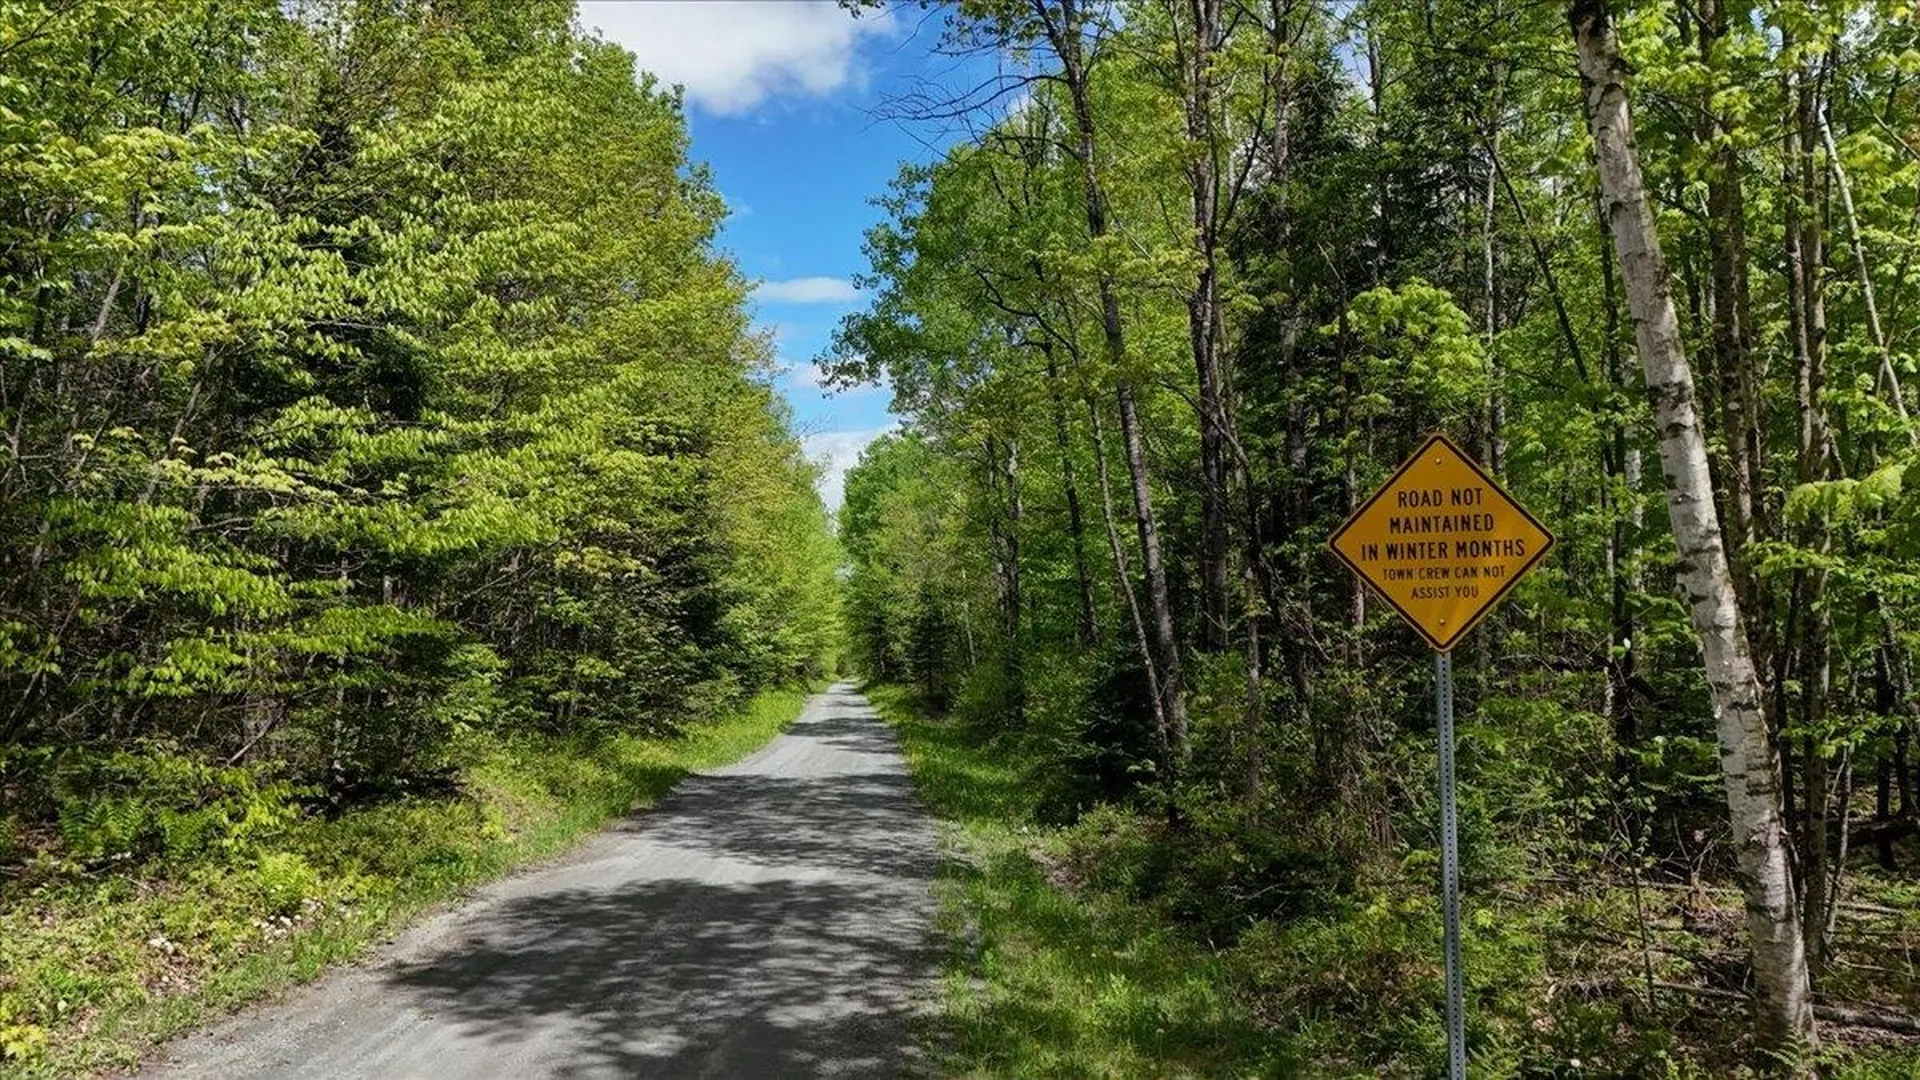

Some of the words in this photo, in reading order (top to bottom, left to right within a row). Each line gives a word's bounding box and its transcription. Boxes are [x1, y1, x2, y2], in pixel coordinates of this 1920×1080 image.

[1397, 489, 1442, 508] ROAD
[1451, 488, 1483, 506] NOT
[1390, 513, 1494, 534] MAINTAINED
[1362, 544, 1378, 561] IN
[1386, 542, 1448, 561] WINTER
[1456, 539, 1525, 558] MONTHS
[1383, 569, 1413, 581] TOWN
[1419, 567, 1450, 579] CREW
[1455, 566, 1478, 578] CAN
[1484, 566, 1506, 578] NOT
[1411, 587, 1450, 599] ASSIST
[1455, 586, 1479, 598] YOU
